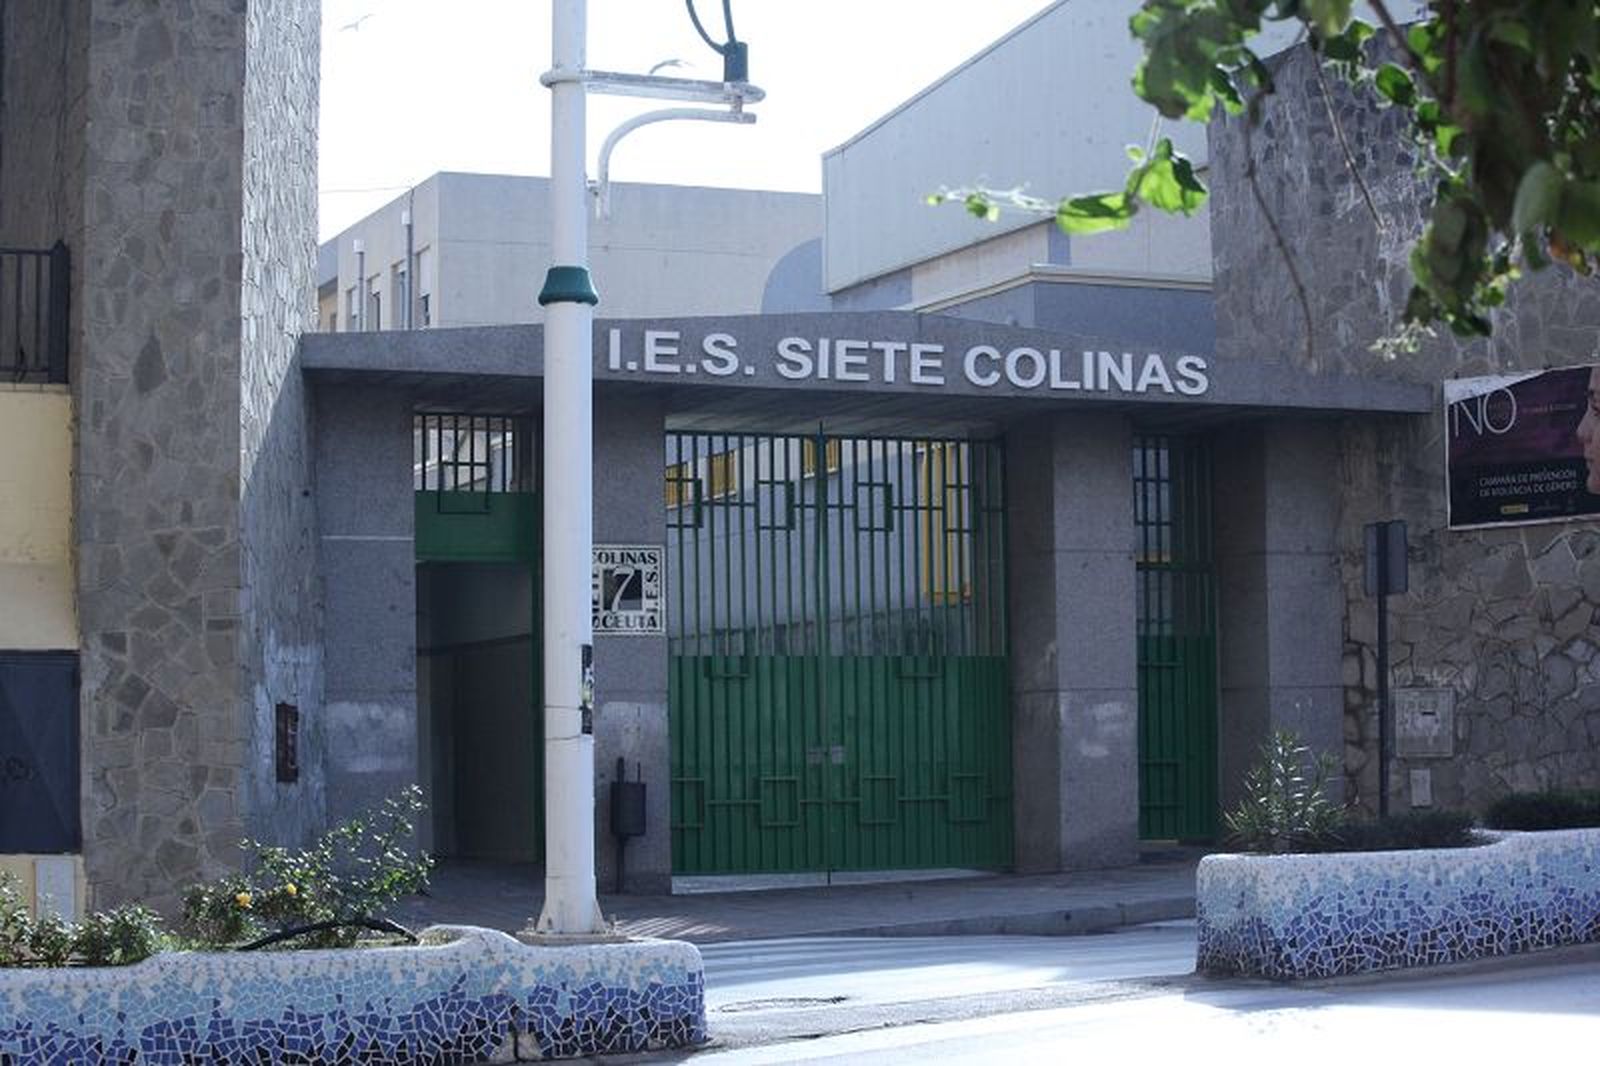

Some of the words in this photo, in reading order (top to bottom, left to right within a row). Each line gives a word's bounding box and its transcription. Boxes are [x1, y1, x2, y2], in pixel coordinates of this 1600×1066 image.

[609, 329, 755, 375] I.E.S.
[776, 337, 945, 385] SIETE
[963, 345, 1209, 395] COLINAS
[1453, 386, 1517, 437] NO
[612, 565, 635, 614] 7
[602, 615, 657, 629] CEUTA
